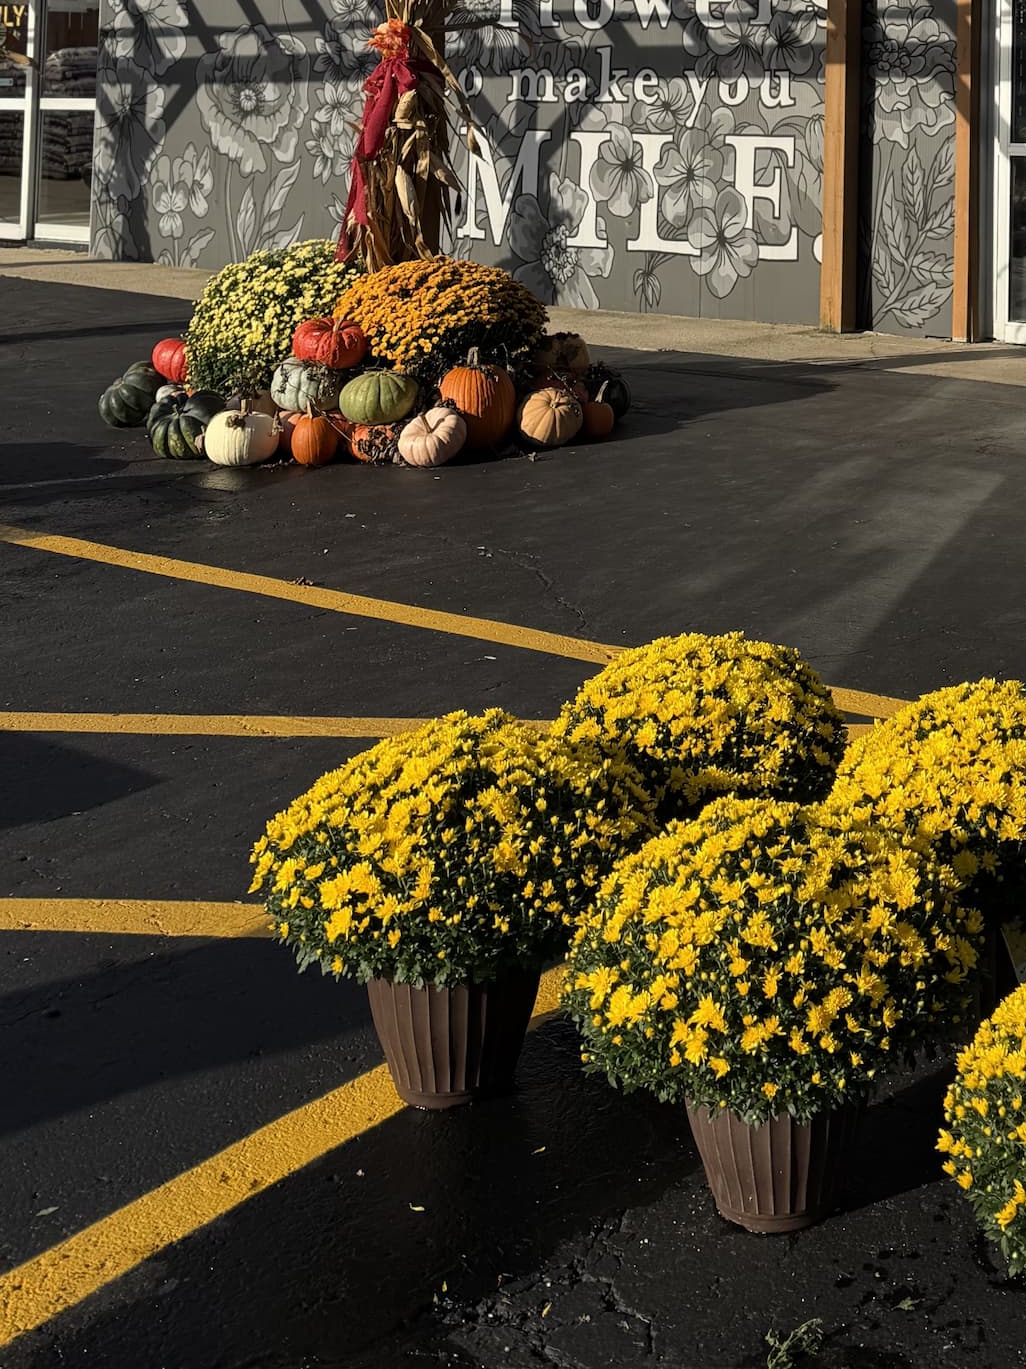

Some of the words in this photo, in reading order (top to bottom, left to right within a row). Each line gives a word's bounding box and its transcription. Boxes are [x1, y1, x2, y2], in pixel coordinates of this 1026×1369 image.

[507, 45, 661, 103] make
[682, 69, 797, 128] you
[457, 126, 823, 264] MILE
